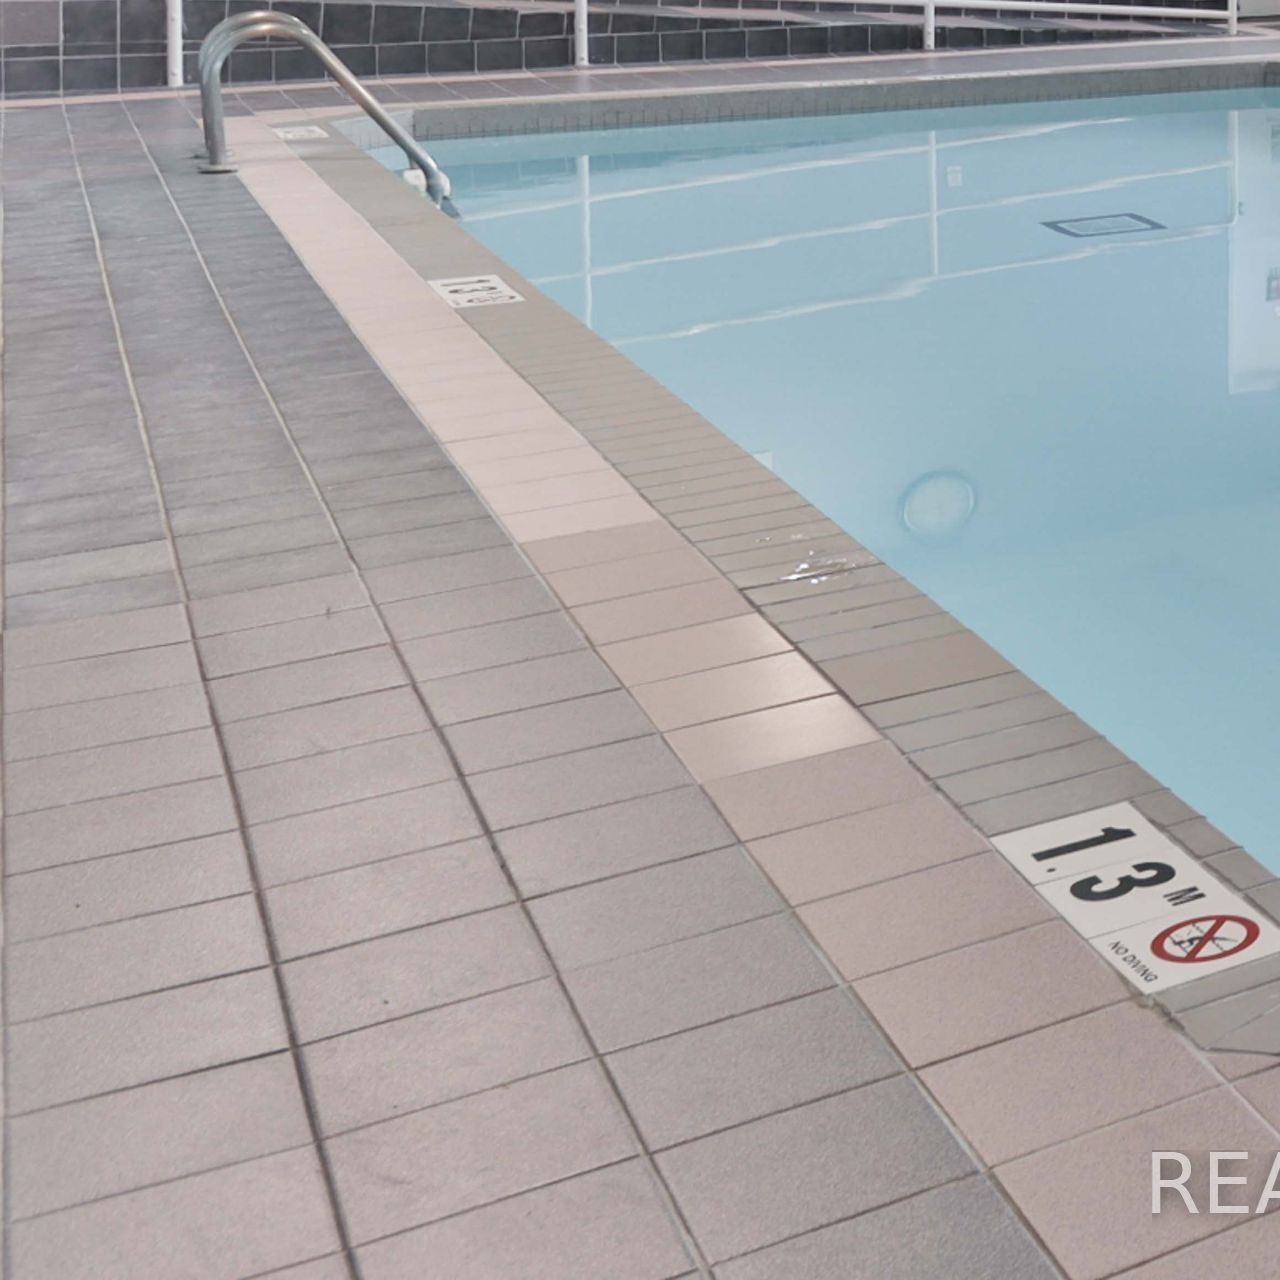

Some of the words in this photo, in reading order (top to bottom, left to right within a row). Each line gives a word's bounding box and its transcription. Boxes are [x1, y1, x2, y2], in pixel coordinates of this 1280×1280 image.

[1031, 826, 1176, 902] 1.3
[1163, 886, 1206, 906] M
[1107, 940, 1128, 957] NO
[1122, 951, 1159, 983] DIVING
